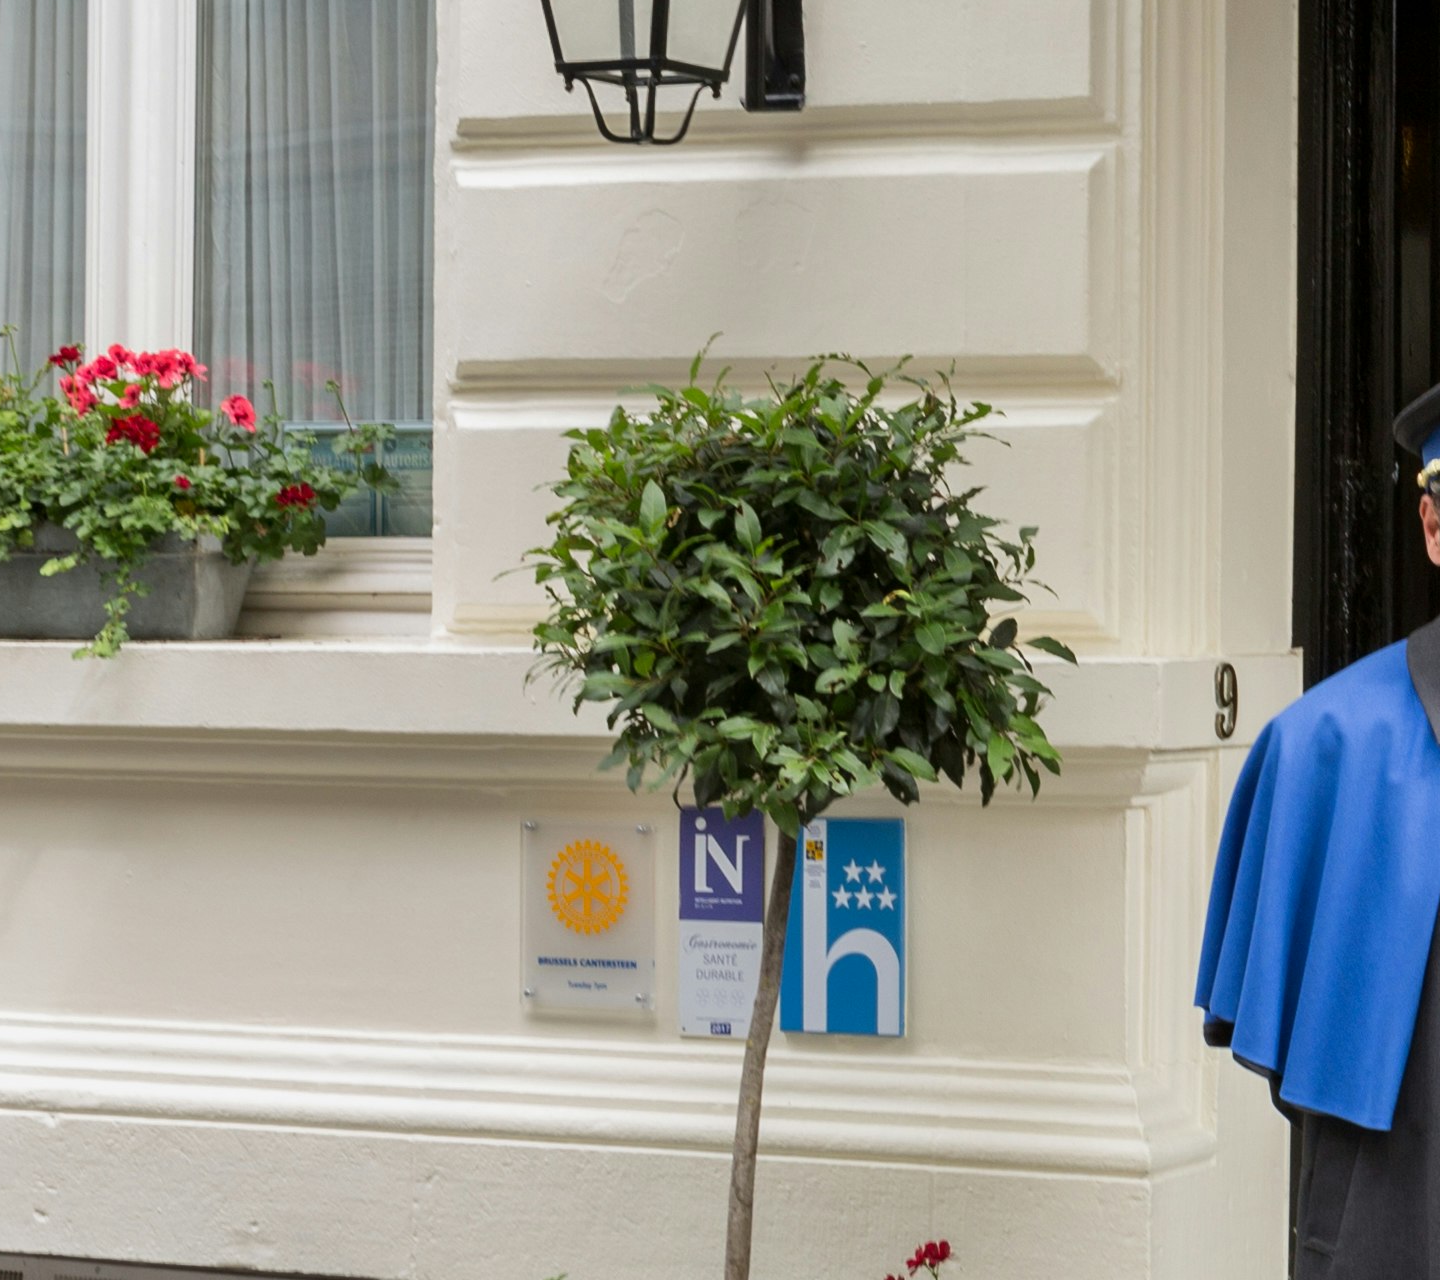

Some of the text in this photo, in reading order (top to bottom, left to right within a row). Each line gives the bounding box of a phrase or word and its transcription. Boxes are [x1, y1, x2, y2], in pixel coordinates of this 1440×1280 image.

[1214, 662, 1238, 740] 9
[685, 934, 758, 951] Gastronomie
[537, 957, 637, 969] BRUSSELS CANTERSTEEN
[703, 953, 737, 966] SANTÉ
[696, 968, 745, 982] DURABLE
